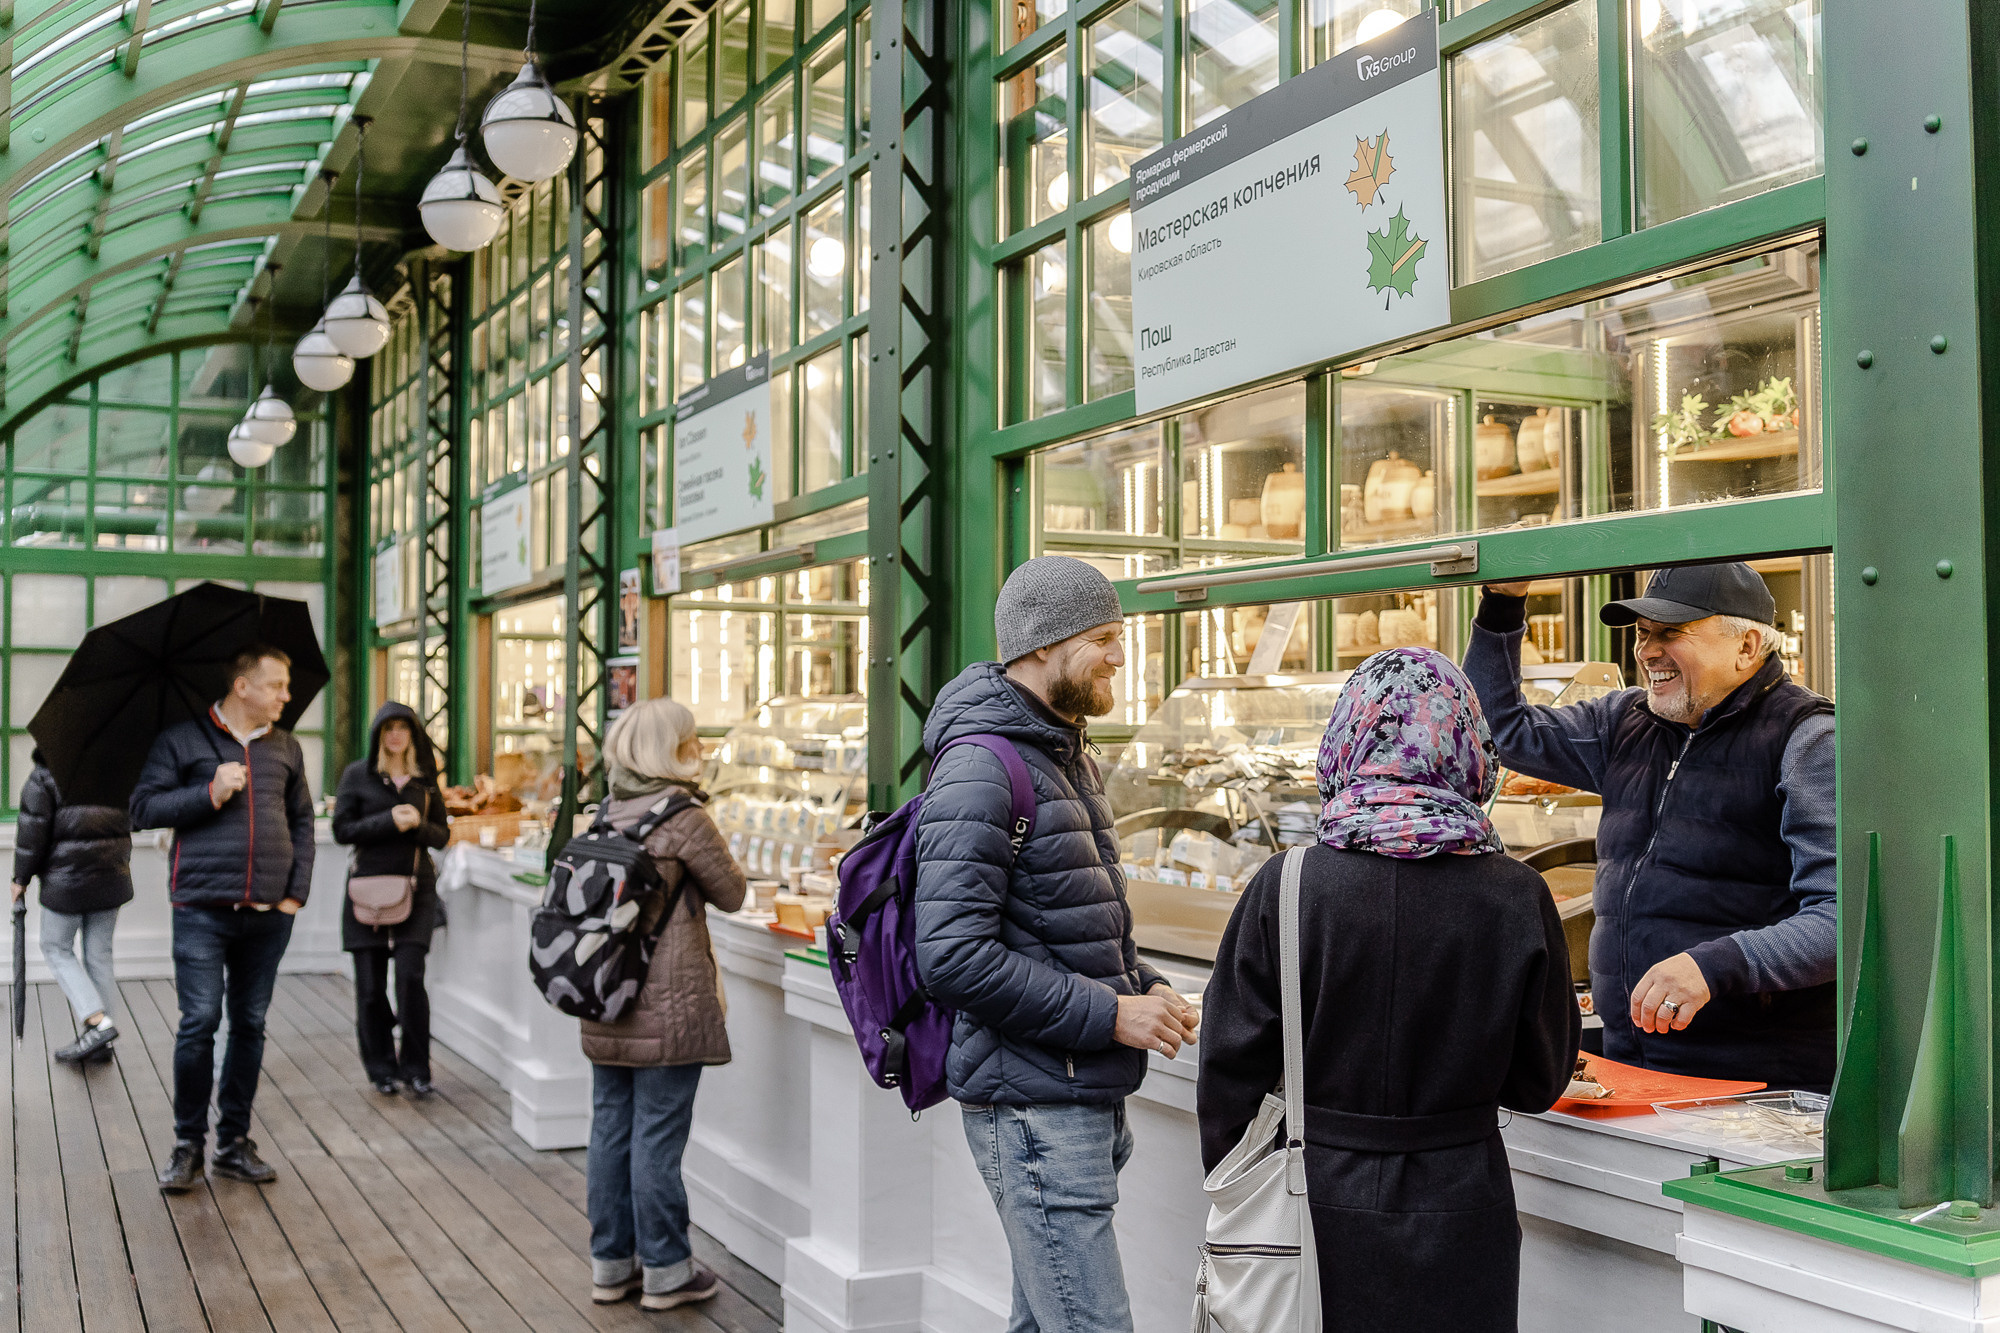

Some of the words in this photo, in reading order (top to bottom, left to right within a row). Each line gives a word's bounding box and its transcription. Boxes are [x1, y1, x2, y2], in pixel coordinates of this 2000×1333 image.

[1135, 157, 1172, 184] Ярмарка
[1172, 123, 1228, 167] фермерской
[1135, 169, 1181, 201] продукции
[1137, 196, 1228, 254] Мастерская
[1233, 154, 1321, 210] копчения
[1137, 251, 1184, 282] Кировская
[1184, 237, 1222, 262] область
[1140, 324, 1172, 351] Пош
[1141, 353, 1192, 380] Республика
[1193, 338, 1237, 365] Дагестан
